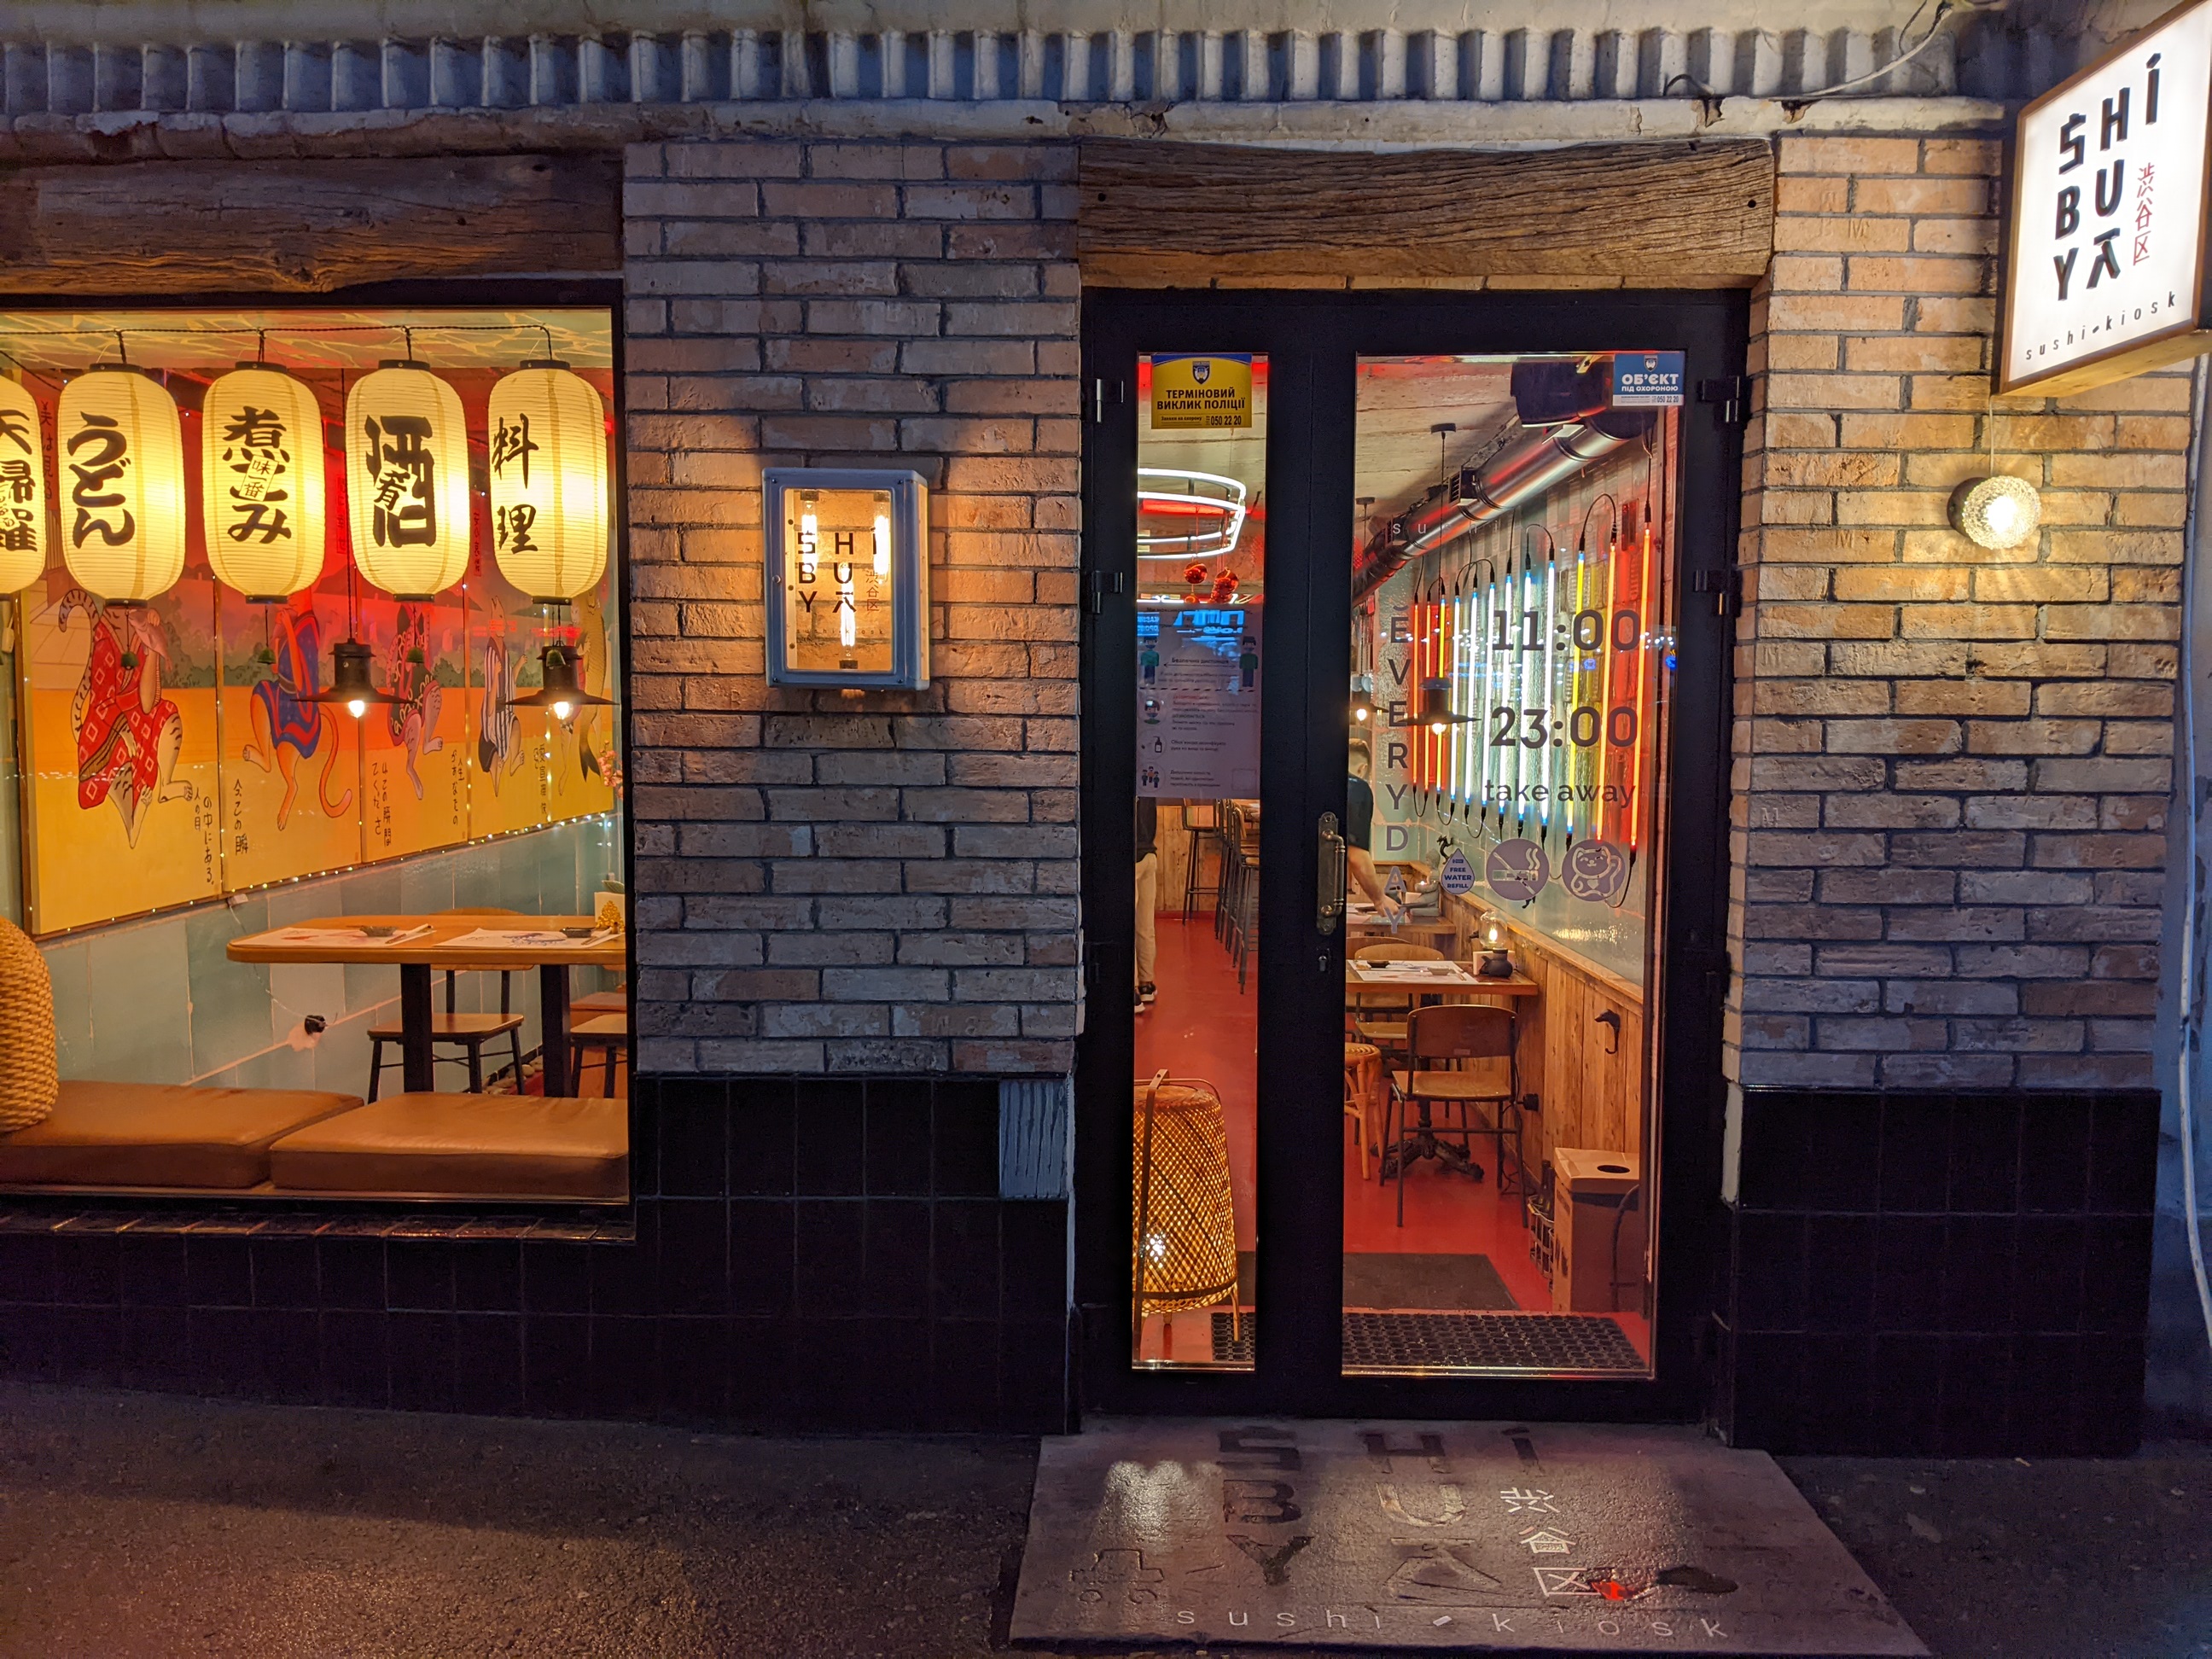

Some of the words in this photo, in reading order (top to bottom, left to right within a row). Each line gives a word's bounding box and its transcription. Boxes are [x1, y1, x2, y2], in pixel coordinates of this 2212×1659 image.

[2054, 159, 2125, 241] BU
[1157, 399, 1202, 410] ВИКЛИК
[1204, 397, 1246, 410] ПОЛІЦІЇ
[1166, 387, 1236, 399] ТЕРМІНОВИЙ
[1210, 416, 1223, 426] 050
[1224, 416, 1232, 426] 22
[1233, 415, 1242, 425] 20
[67, 410, 136, 550] うどん
[492, 413, 539, 555] 料理
[1492, 609, 1640, 651] 11:00
[1490, 706, 1639, 748] 23:00
[1485, 778, 1549, 802] take
[1557, 784, 1637, 808] away
